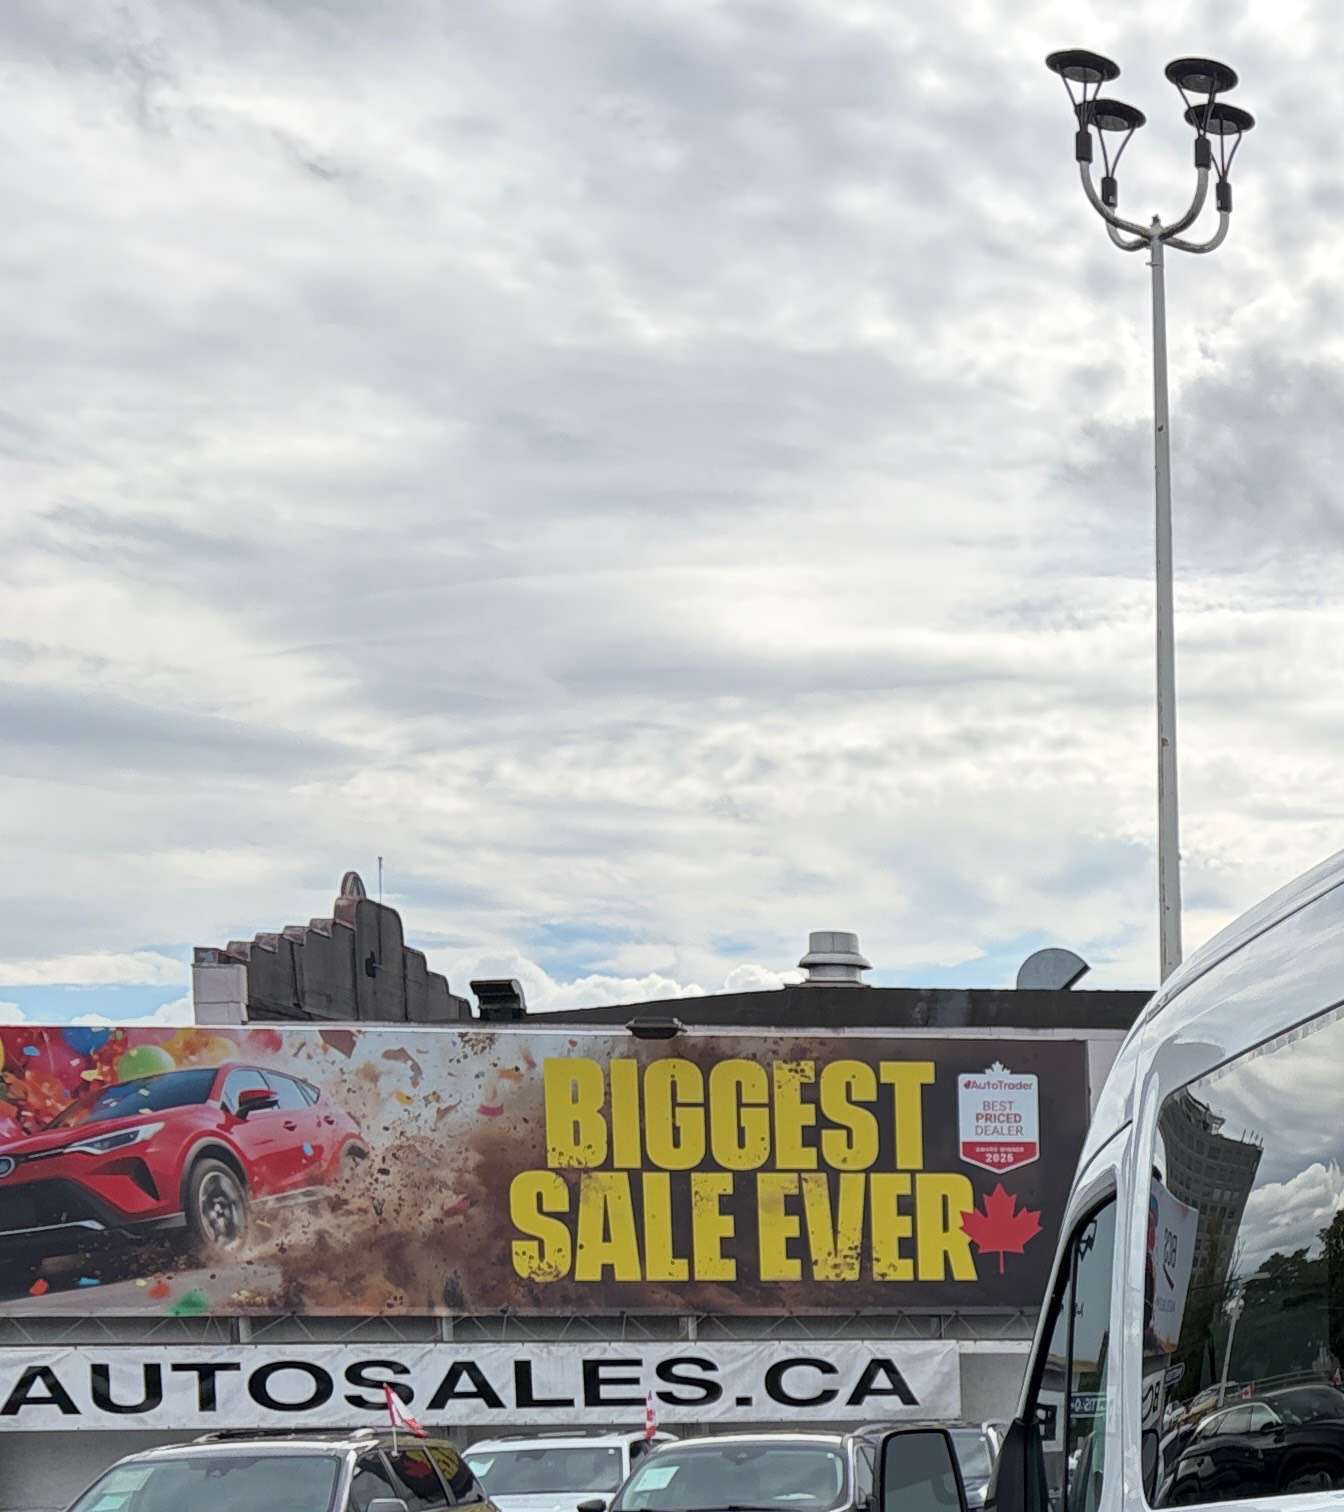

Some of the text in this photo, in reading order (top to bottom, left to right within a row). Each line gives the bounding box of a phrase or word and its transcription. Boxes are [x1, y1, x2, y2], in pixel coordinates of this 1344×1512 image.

[971, 1080, 1033, 1090] AutoTrader
[983, 1101, 1015, 1111] BEST
[544, 1058, 935, 1170] BIGGEST
[976, 1113, 1022, 1123] PRICED
[975, 1125, 1024, 1136] DEALER
[985, 1154, 1014, 1163] 2025
[509, 1170, 978, 1282] SALE EVER
[0, 1357, 921, 1416] AUTOSALES.CA
